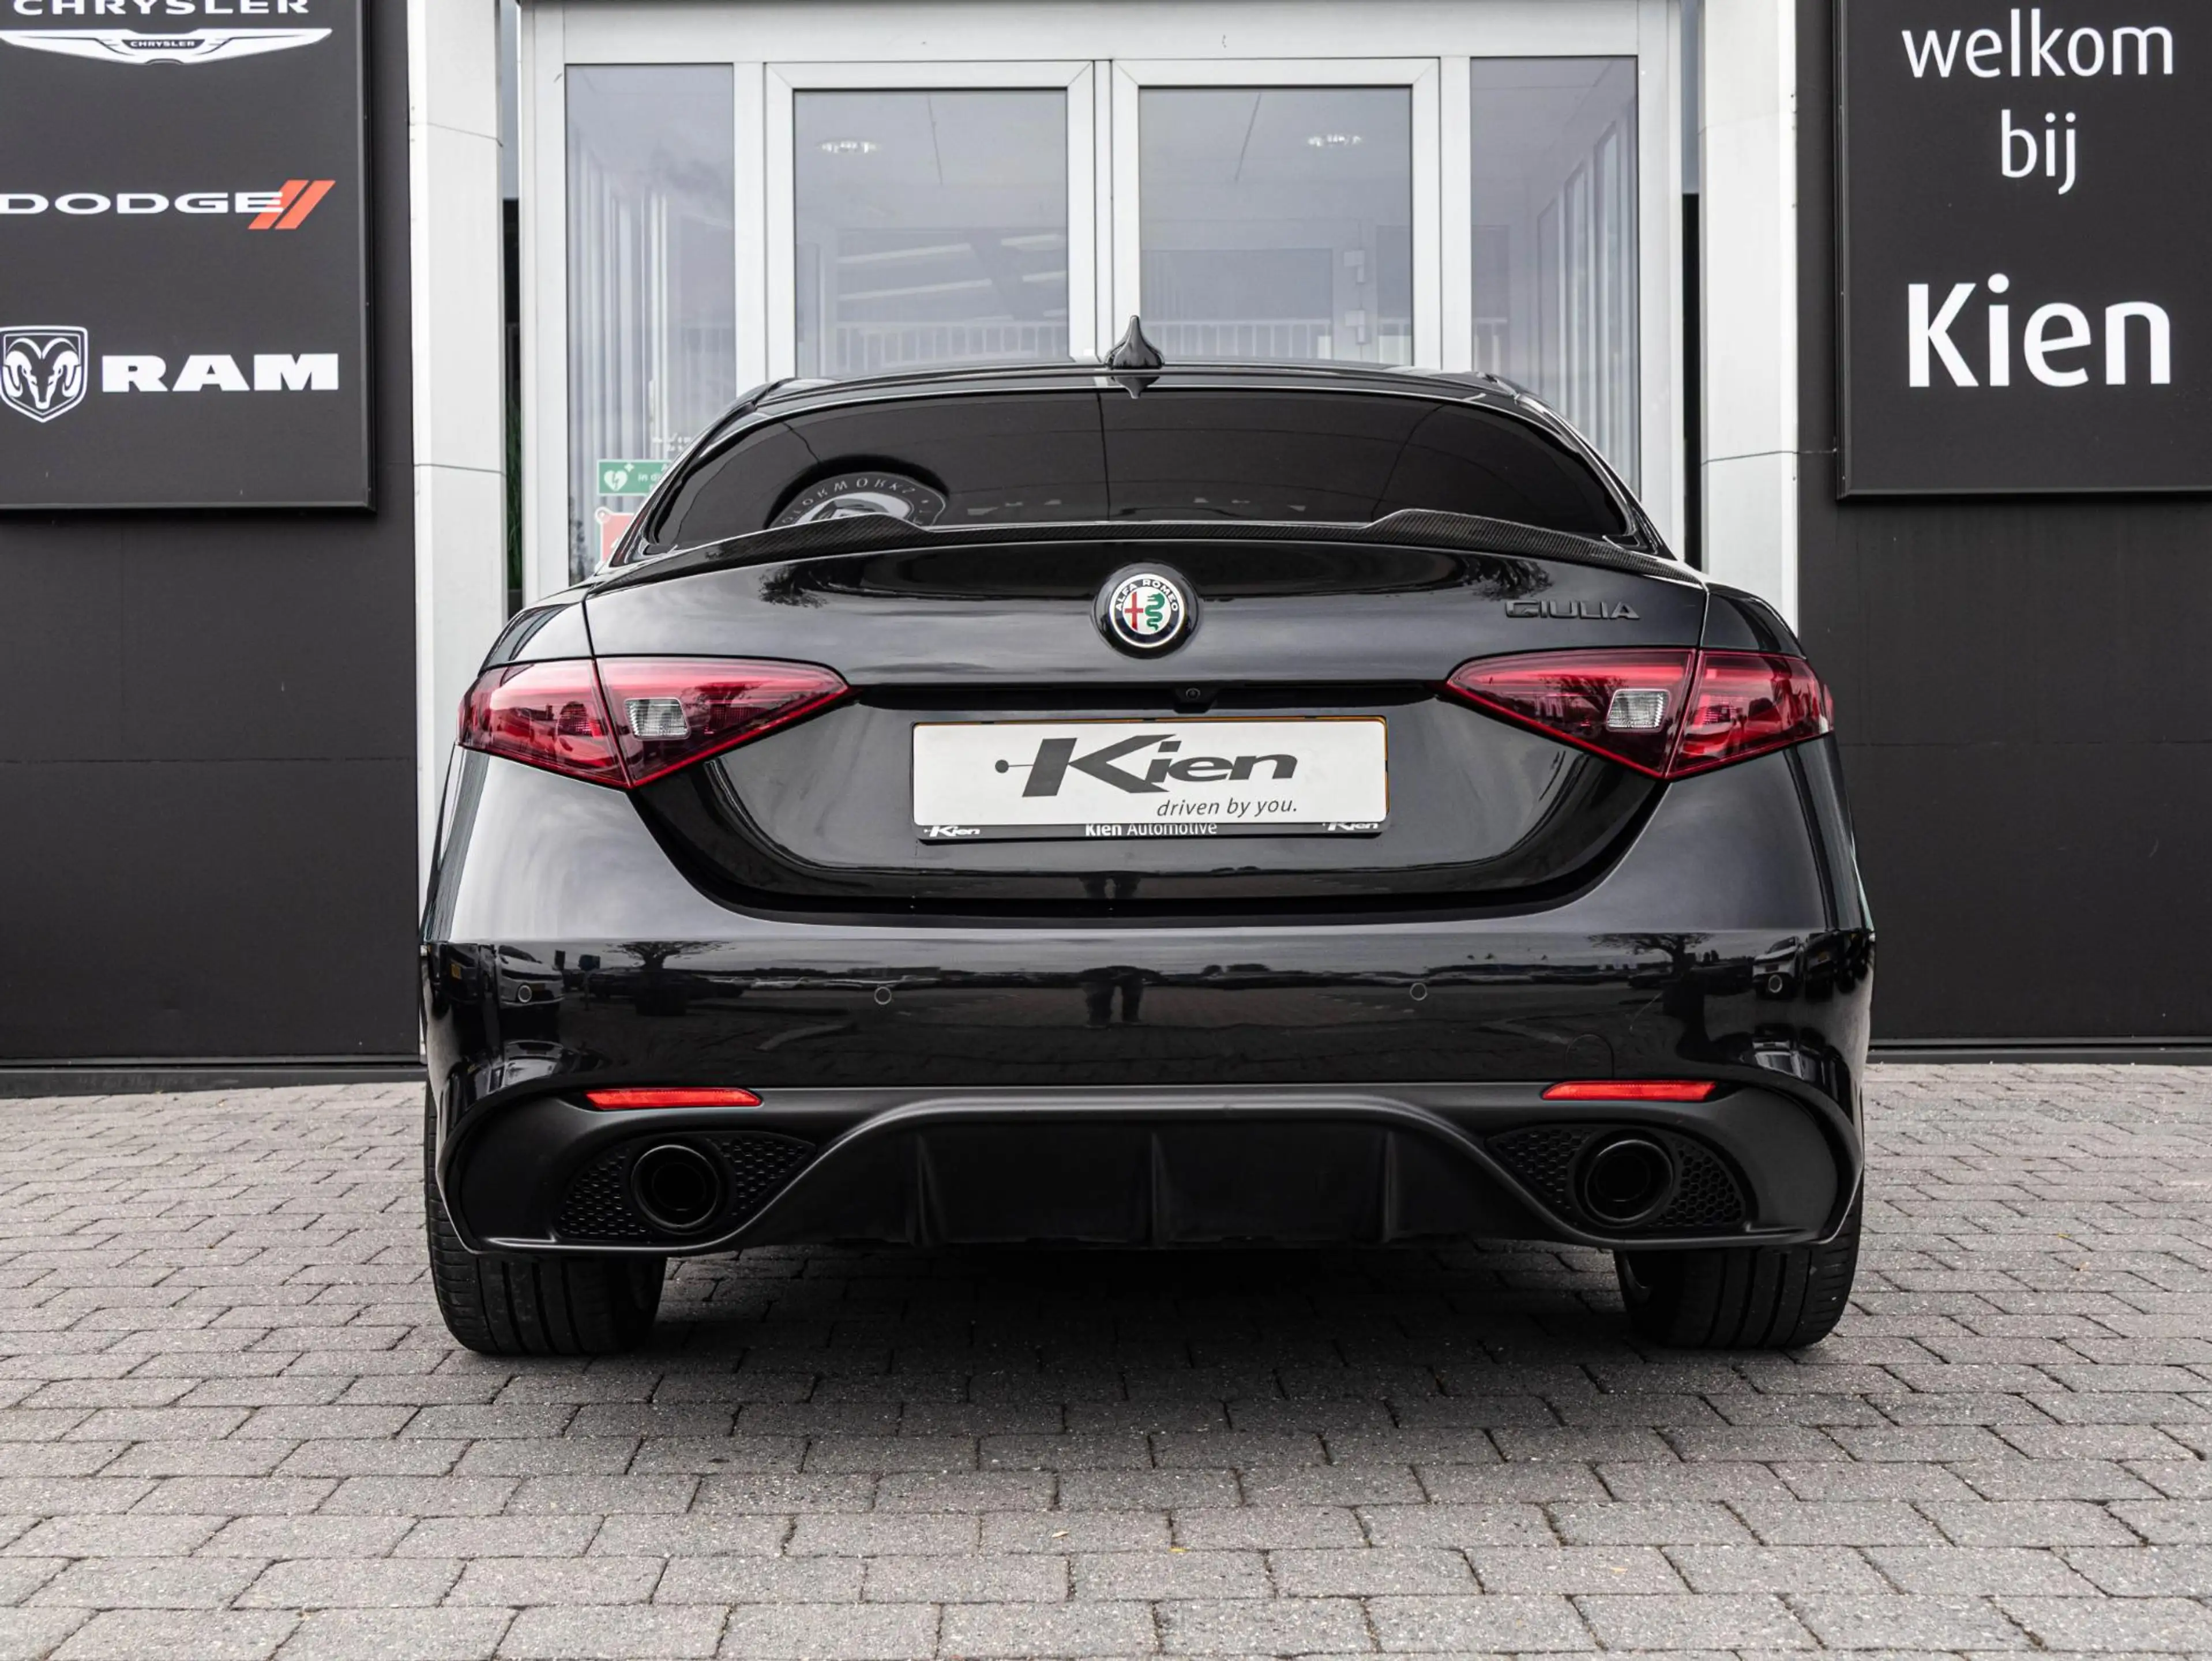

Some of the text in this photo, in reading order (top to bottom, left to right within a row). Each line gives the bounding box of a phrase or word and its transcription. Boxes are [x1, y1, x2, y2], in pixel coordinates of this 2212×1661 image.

[12, 0, 309, 15] CHRYSLER
[1901, 8, 2174, 78] welkom
[2001, 109, 2076, 195] bij
[0, 192, 283, 215] DODGE
[1908, 273, 2170, 388] Kien
[102, 353, 339, 392] RAM
[1116, 578, 1179, 612] ALFA ROMEO
[1505, 600, 1640, 620] GIULIA
[1022, 734, 1298, 798] Kien
[1156, 796, 1297, 818] driven by you.
[929, 825, 981, 837] Kien
[1085, 822, 1218, 836] Kien Automotive
